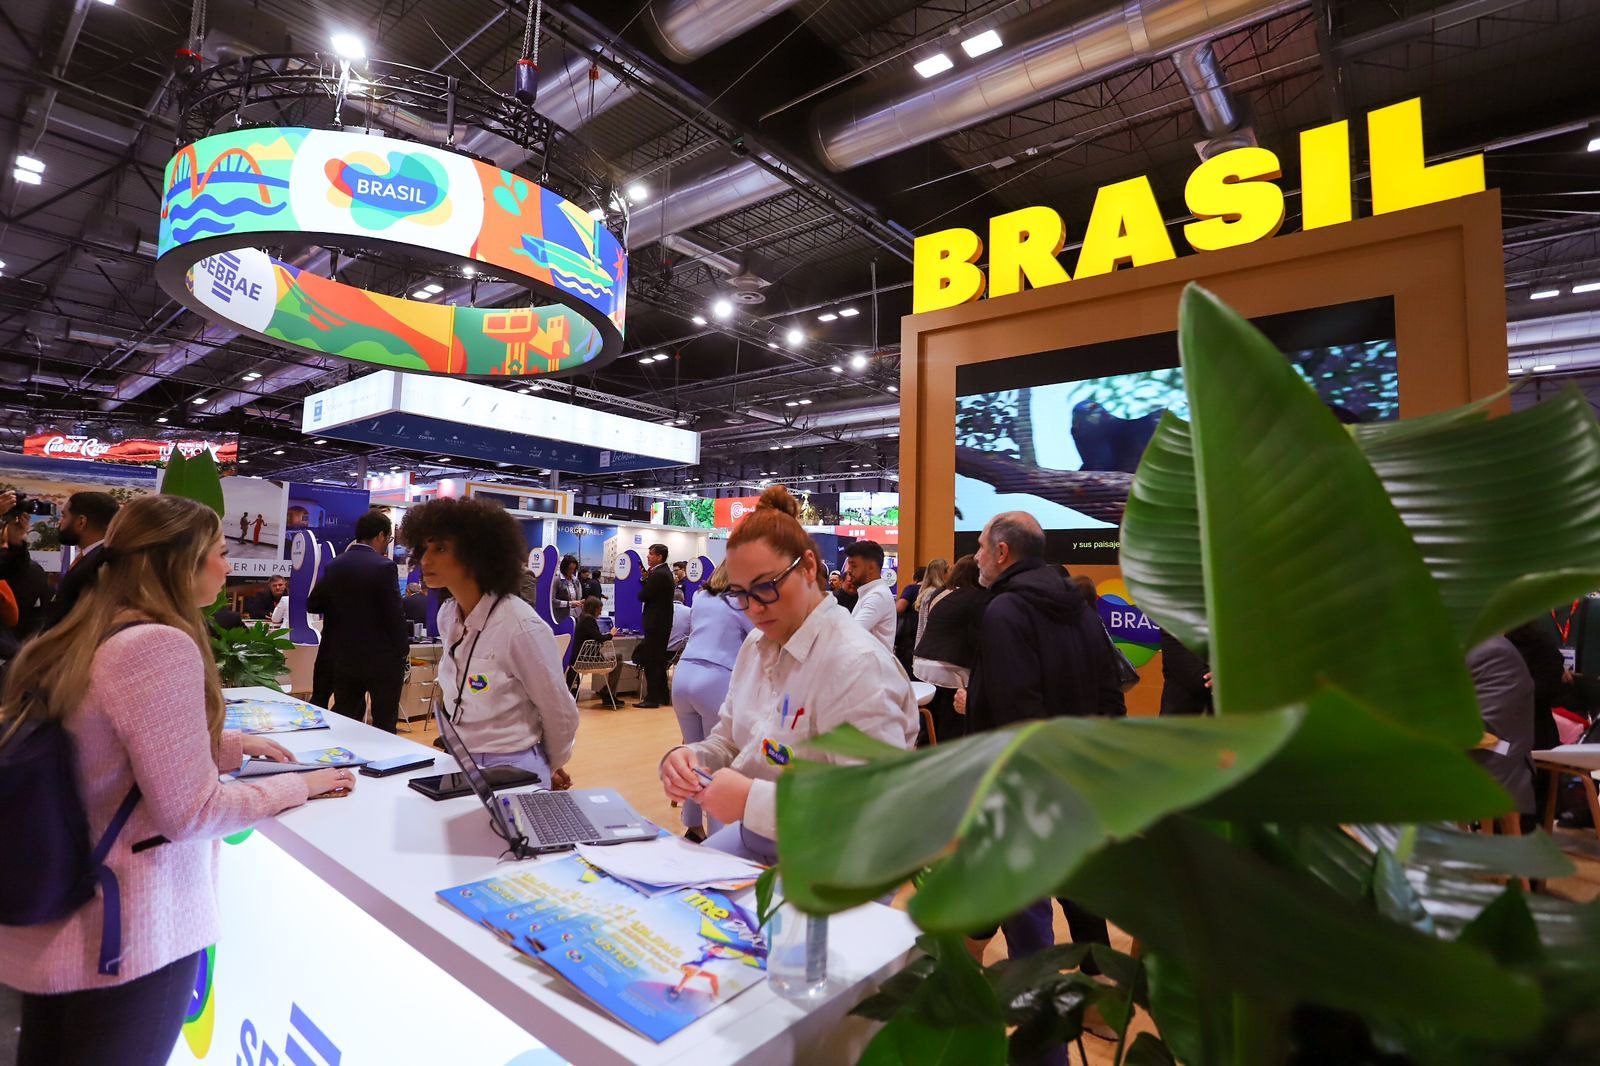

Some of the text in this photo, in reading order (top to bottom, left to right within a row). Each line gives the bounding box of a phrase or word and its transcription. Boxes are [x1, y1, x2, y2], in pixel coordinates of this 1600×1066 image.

[356, 179, 427, 205] BRASIL
[913, 97, 1486, 314] BRASIL
[200, 256, 262, 301] SEBRAE
[79, 437, 111, 456] Rico
[1072, 542, 1078, 550] y
[253, 563, 266, 573] IN
[619, 557, 626, 566] 20
[691, 562, 697, 570] 21
